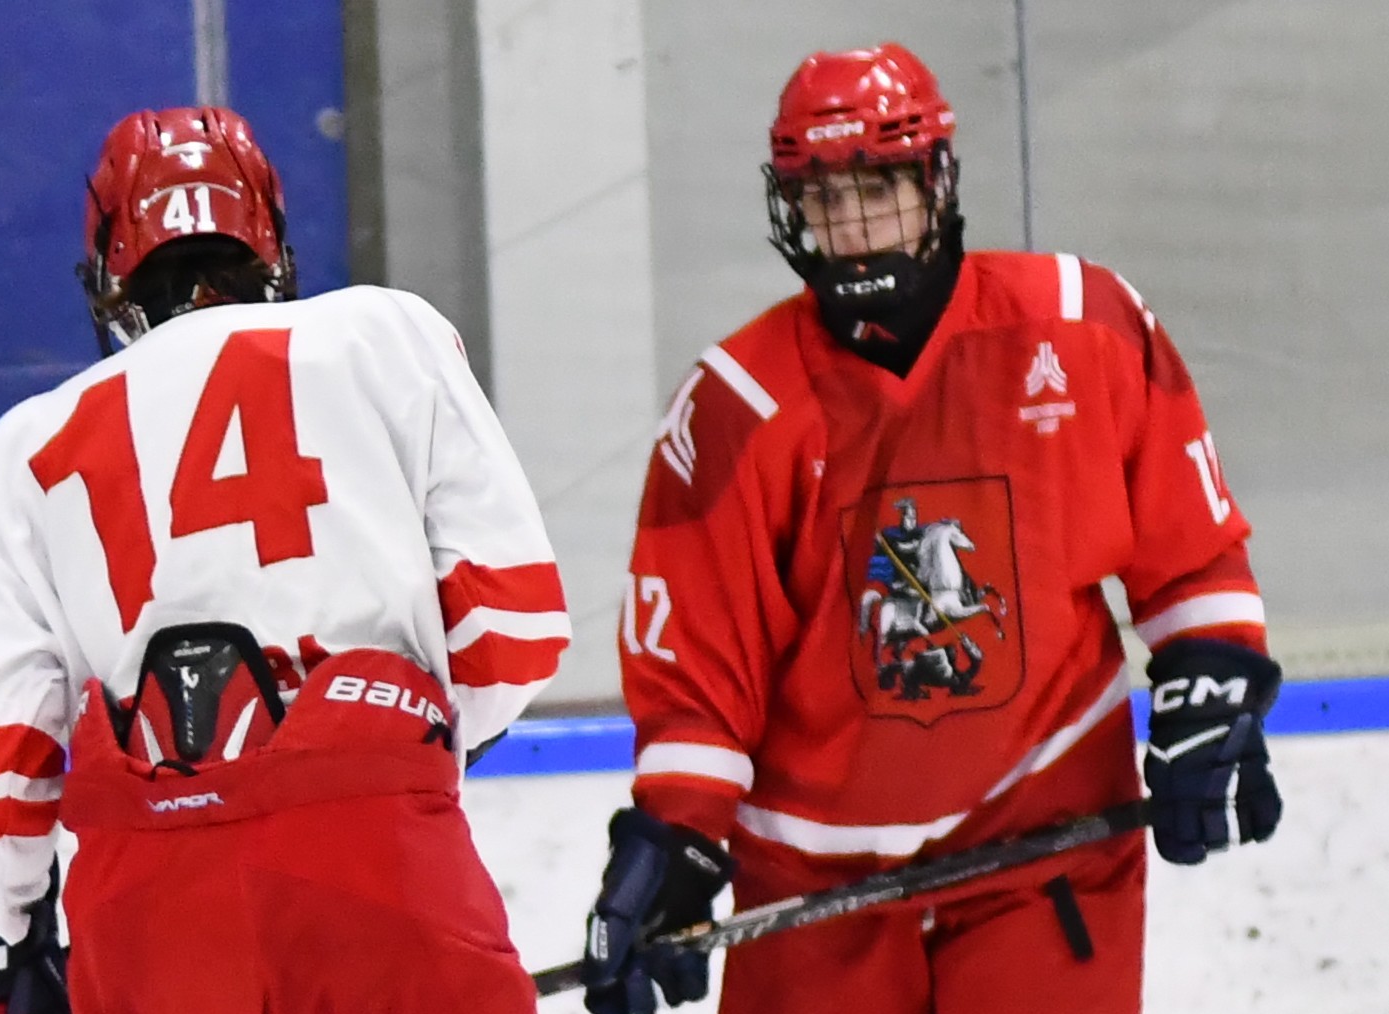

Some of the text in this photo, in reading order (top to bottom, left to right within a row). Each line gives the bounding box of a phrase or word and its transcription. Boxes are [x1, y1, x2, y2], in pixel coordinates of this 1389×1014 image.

[807, 121, 865, 141] CCM
[163, 186, 217, 234] 41
[28, 327, 329, 635] 14
[622, 572, 677, 662] 12
[324, 675, 449, 726] Baue
